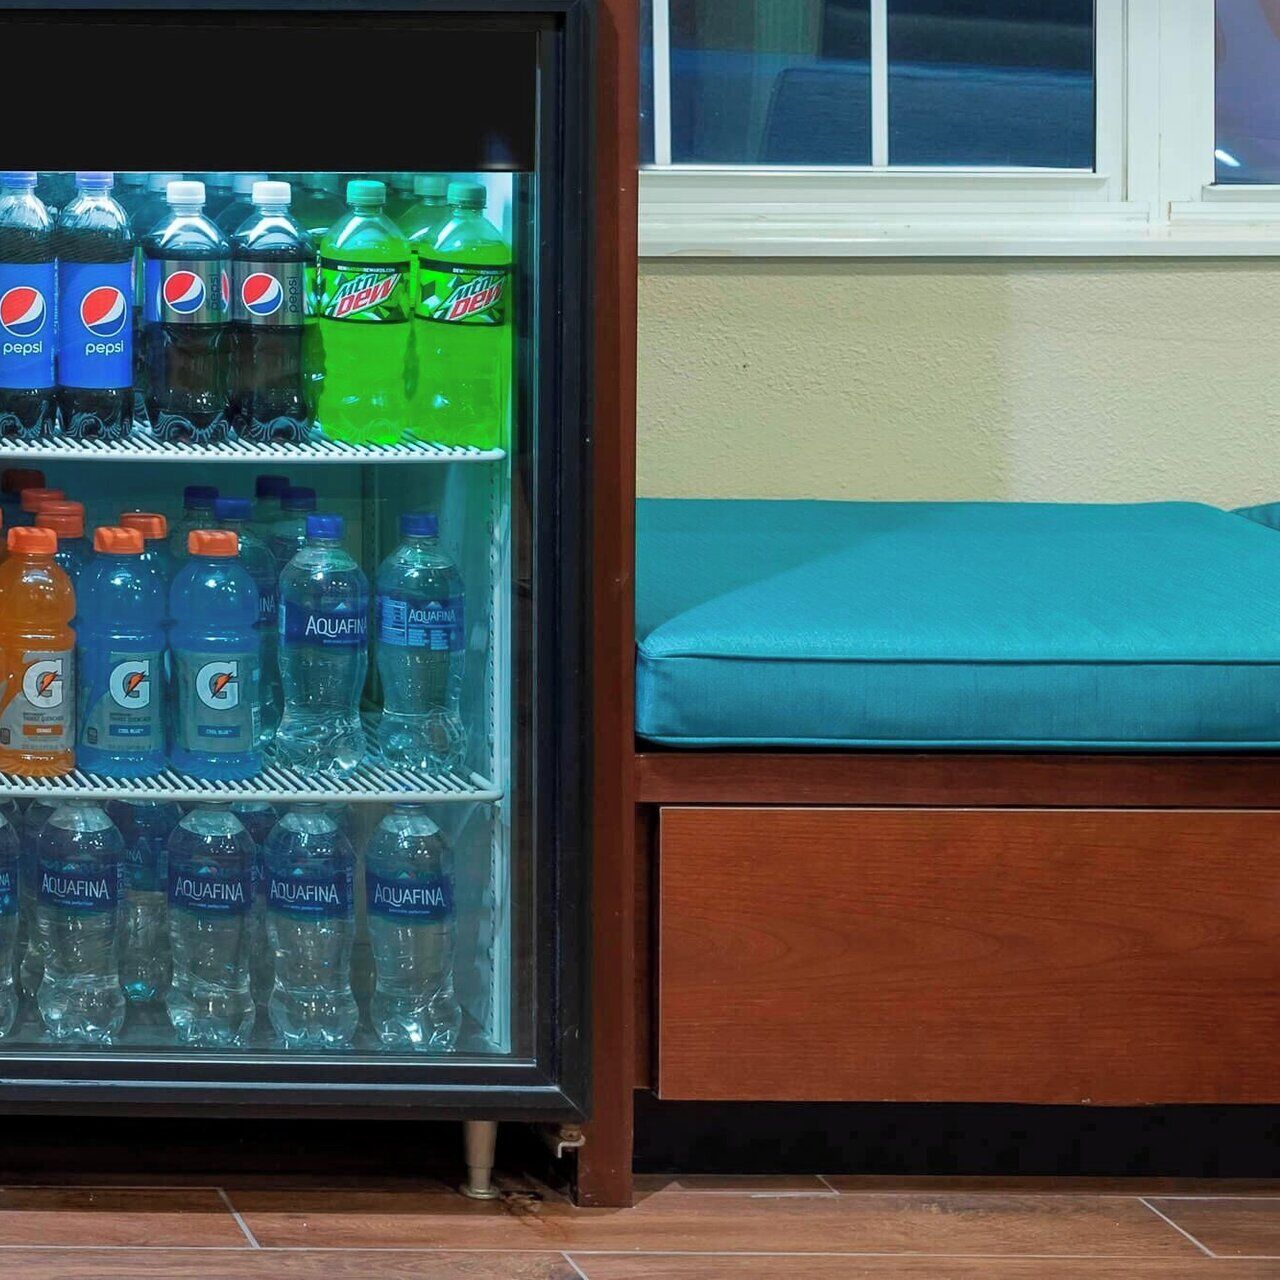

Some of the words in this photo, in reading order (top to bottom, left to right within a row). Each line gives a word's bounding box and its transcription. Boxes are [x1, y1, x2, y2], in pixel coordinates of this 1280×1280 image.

[3, 340, 42, 355] pepsi
[85, 340, 124, 355] pepsi
[42, 873, 109, 900] AQUAFINA
[175, 877, 245, 902] AQUAFINA
